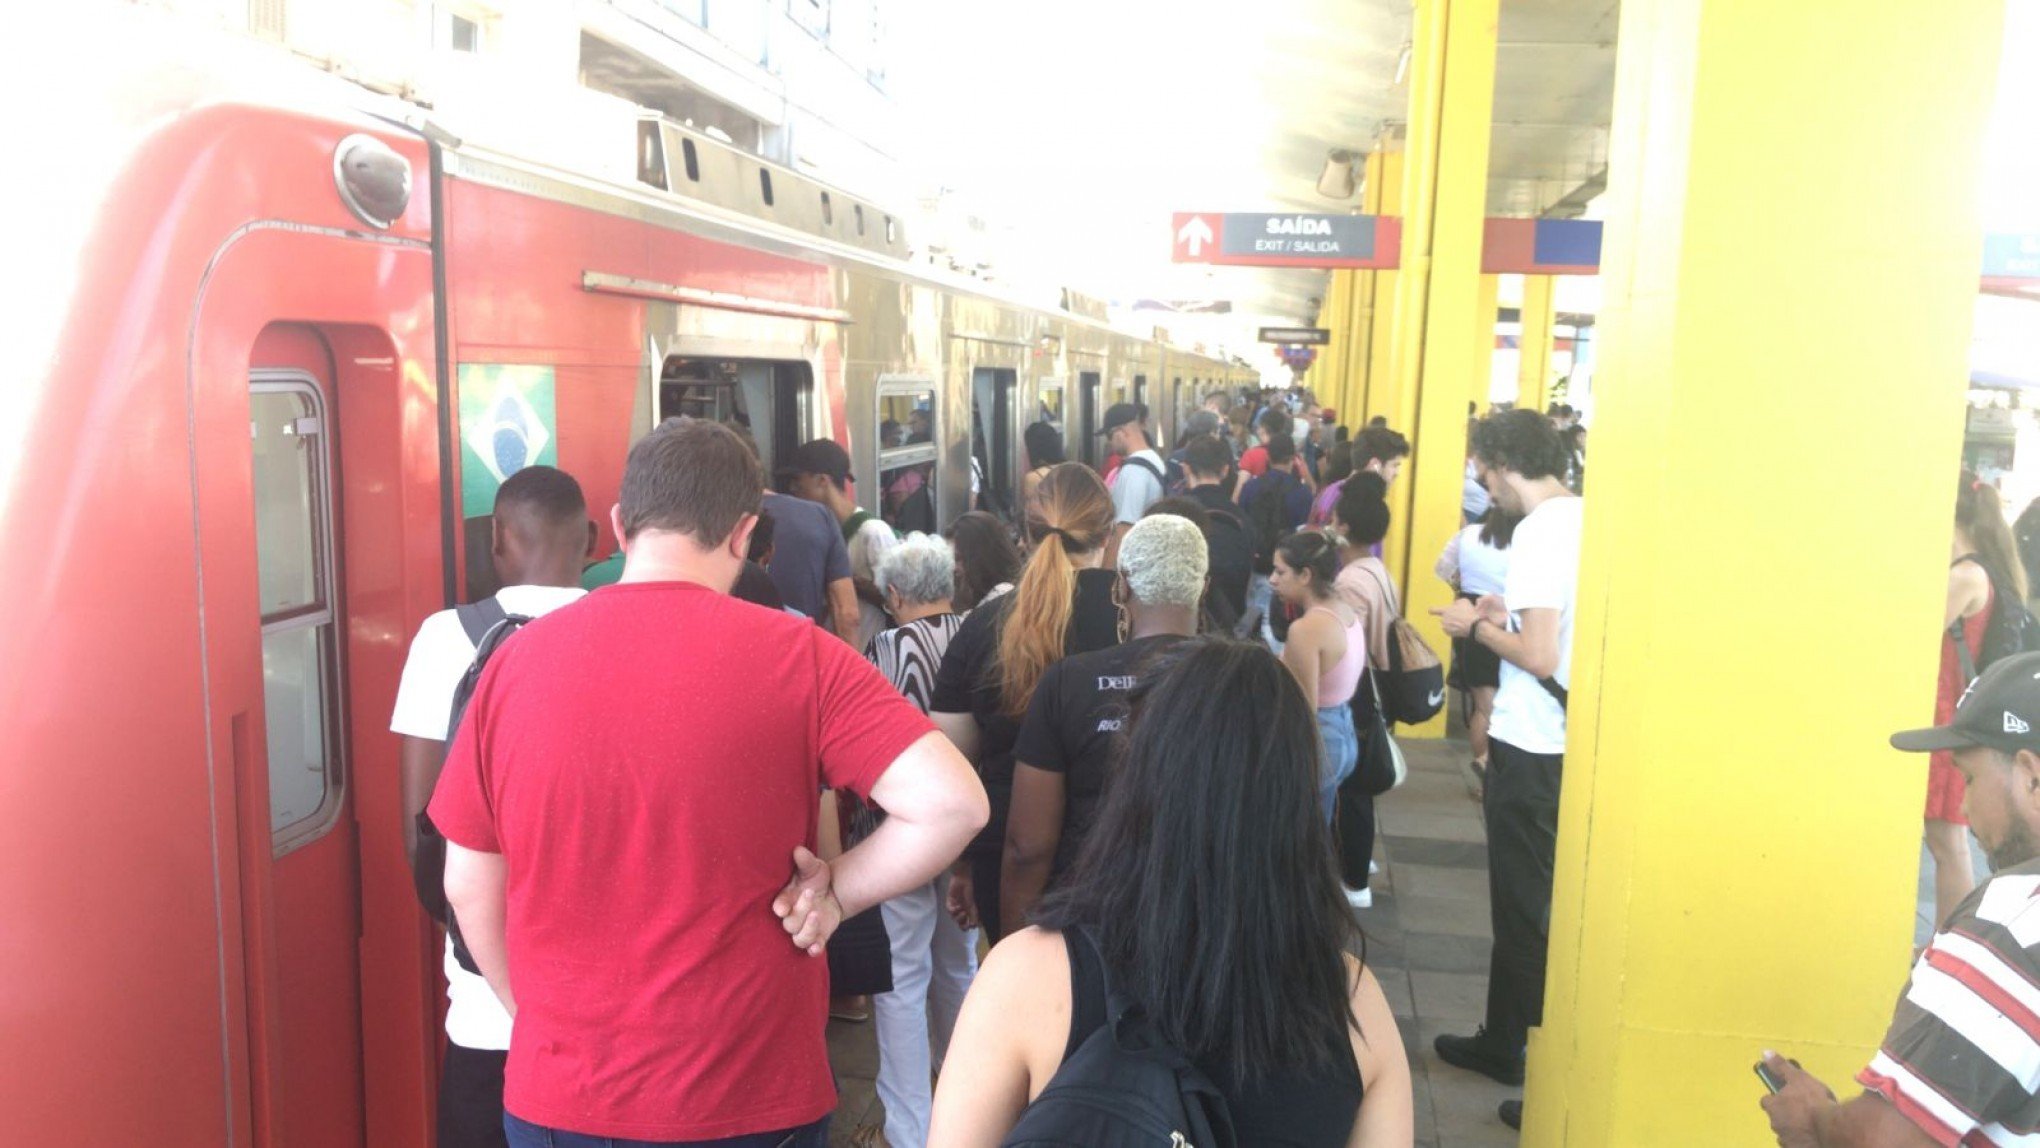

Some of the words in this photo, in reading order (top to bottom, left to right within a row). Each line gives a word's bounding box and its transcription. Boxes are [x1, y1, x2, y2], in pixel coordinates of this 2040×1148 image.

[1266, 215, 1332, 235] SAÍDA
[1256, 240, 1284, 251] EXIT
[1294, 241, 1339, 252] SALIDA
